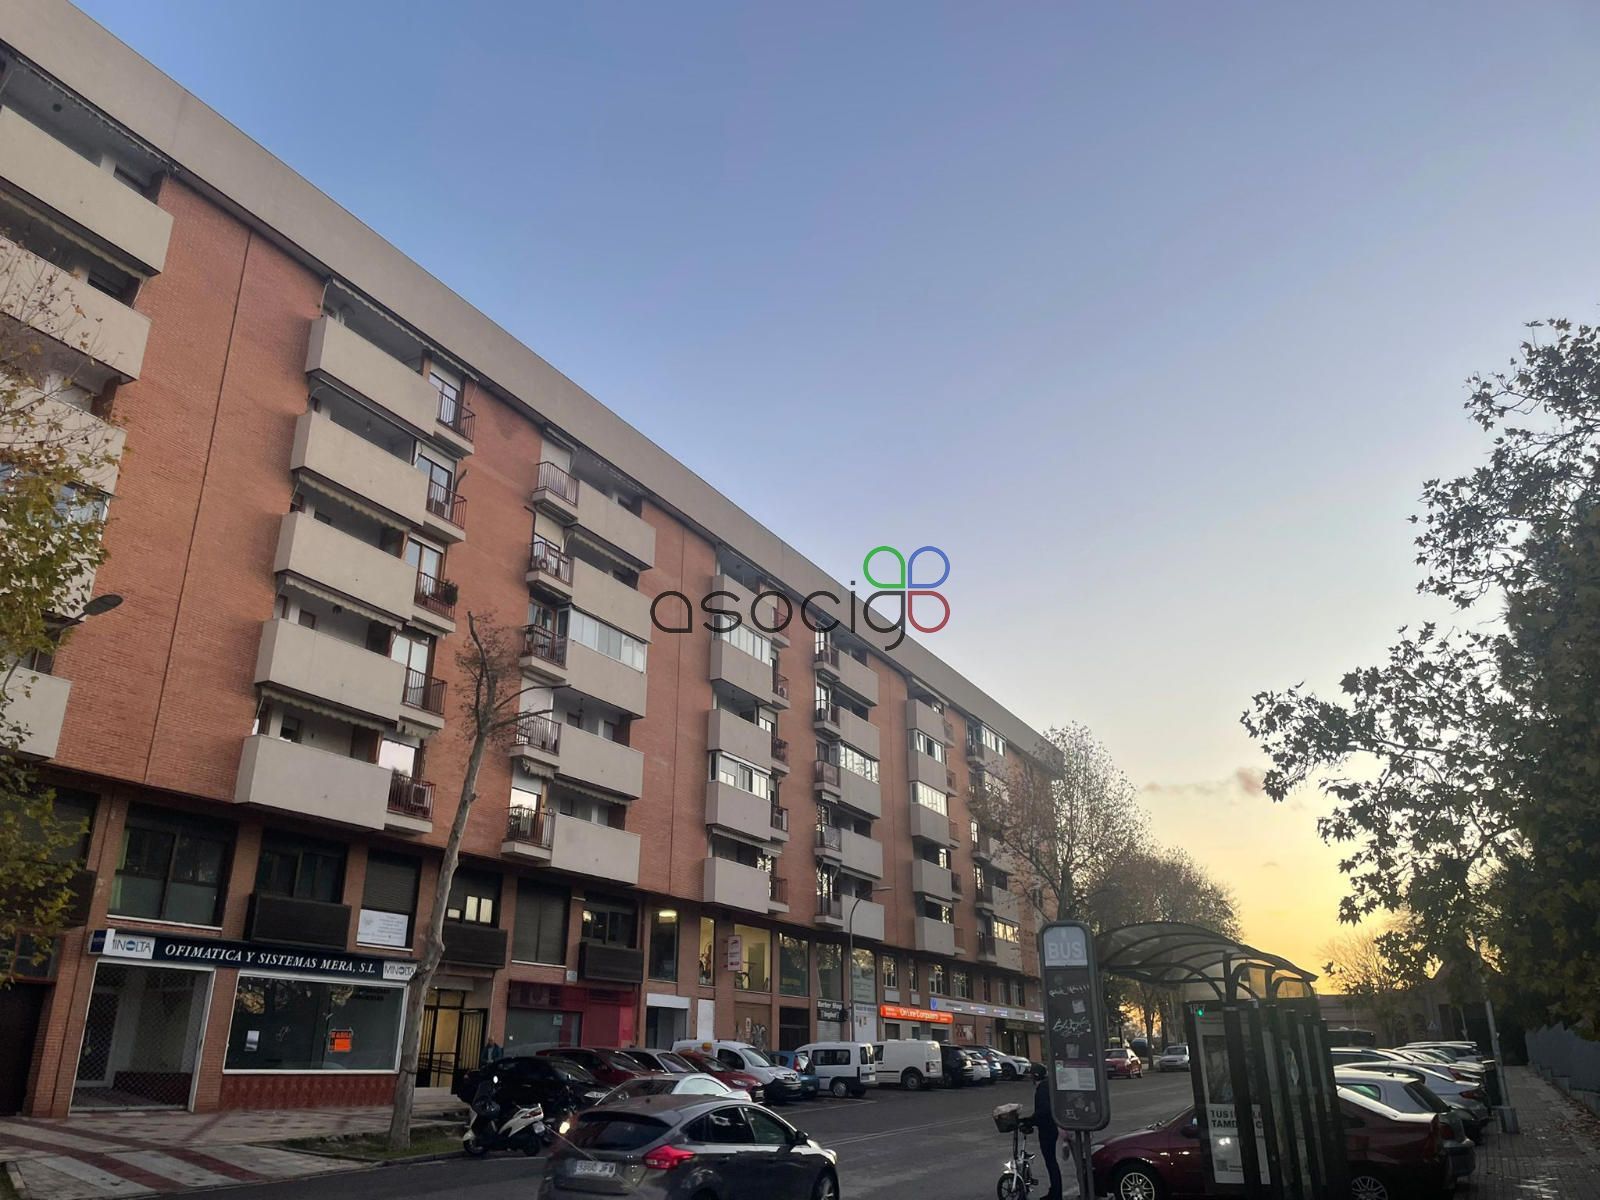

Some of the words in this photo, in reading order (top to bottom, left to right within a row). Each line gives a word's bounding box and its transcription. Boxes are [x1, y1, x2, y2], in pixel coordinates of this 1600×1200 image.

[165, 943, 242, 961] OFIMATICA
[246, 950, 255, 963] Y
[257, 952, 317, 969] SISTEMAS
[320, 959, 356, 973] MERA,
[1048, 942, 1083, 960] BUS
